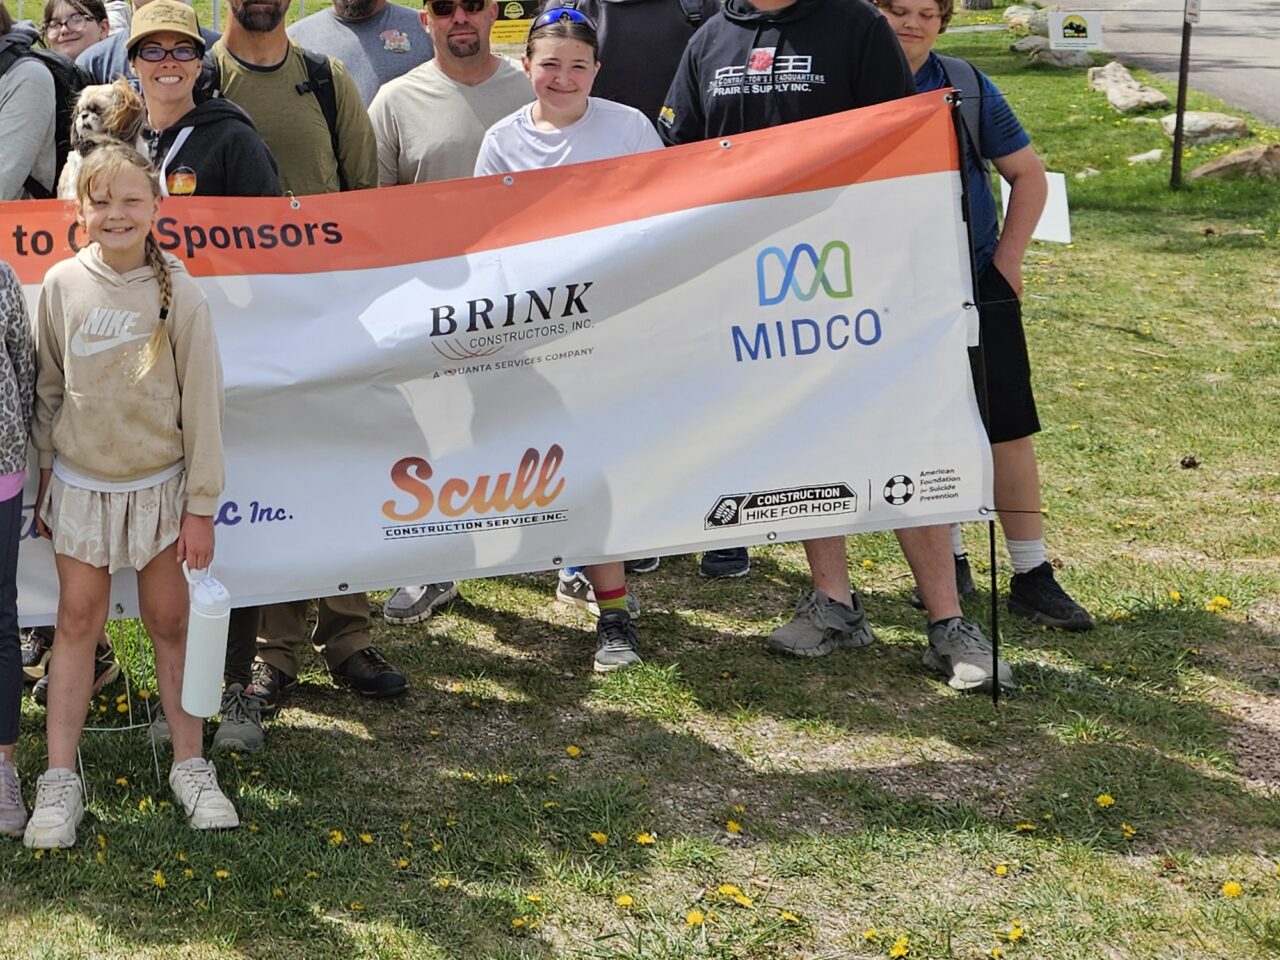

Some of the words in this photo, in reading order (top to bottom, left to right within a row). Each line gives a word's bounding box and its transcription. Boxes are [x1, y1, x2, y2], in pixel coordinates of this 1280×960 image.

[713, 85, 750, 97] PRAIRE
[791, 83, 812, 92] INC.
[13, 224, 54, 256] to
[156, 216, 344, 258] Sponsors
[82, 306, 142, 337] NIKE
[429, 281, 594, 337] BRINK
[469, 323, 568, 350] CONSTRUCTORS,
[572, 318, 595, 333] INC.
[731, 307, 882, 363] MIDCO
[433, 370, 440, 379] A
[494, 356, 543, 371] SERVICES
[545, 347, 595, 362] COMPANY
[381, 443, 567, 522] Scull
[919, 467, 956, 478] American
[920, 473, 961, 487] Foundation
[756, 487, 841, 507] CONSTRUCTION
[928, 483, 956, 493] Suicide
[249, 500, 294, 525] Inc.
[746, 507, 779, 522] HIKE
[781, 504, 808, 517] FOR
[811, 500, 851, 514] HOPE
[385, 521, 484, 537] CONSTRUCTION
[486, 515, 539, 529] SERVICE
[542, 512, 567, 522] INC.
